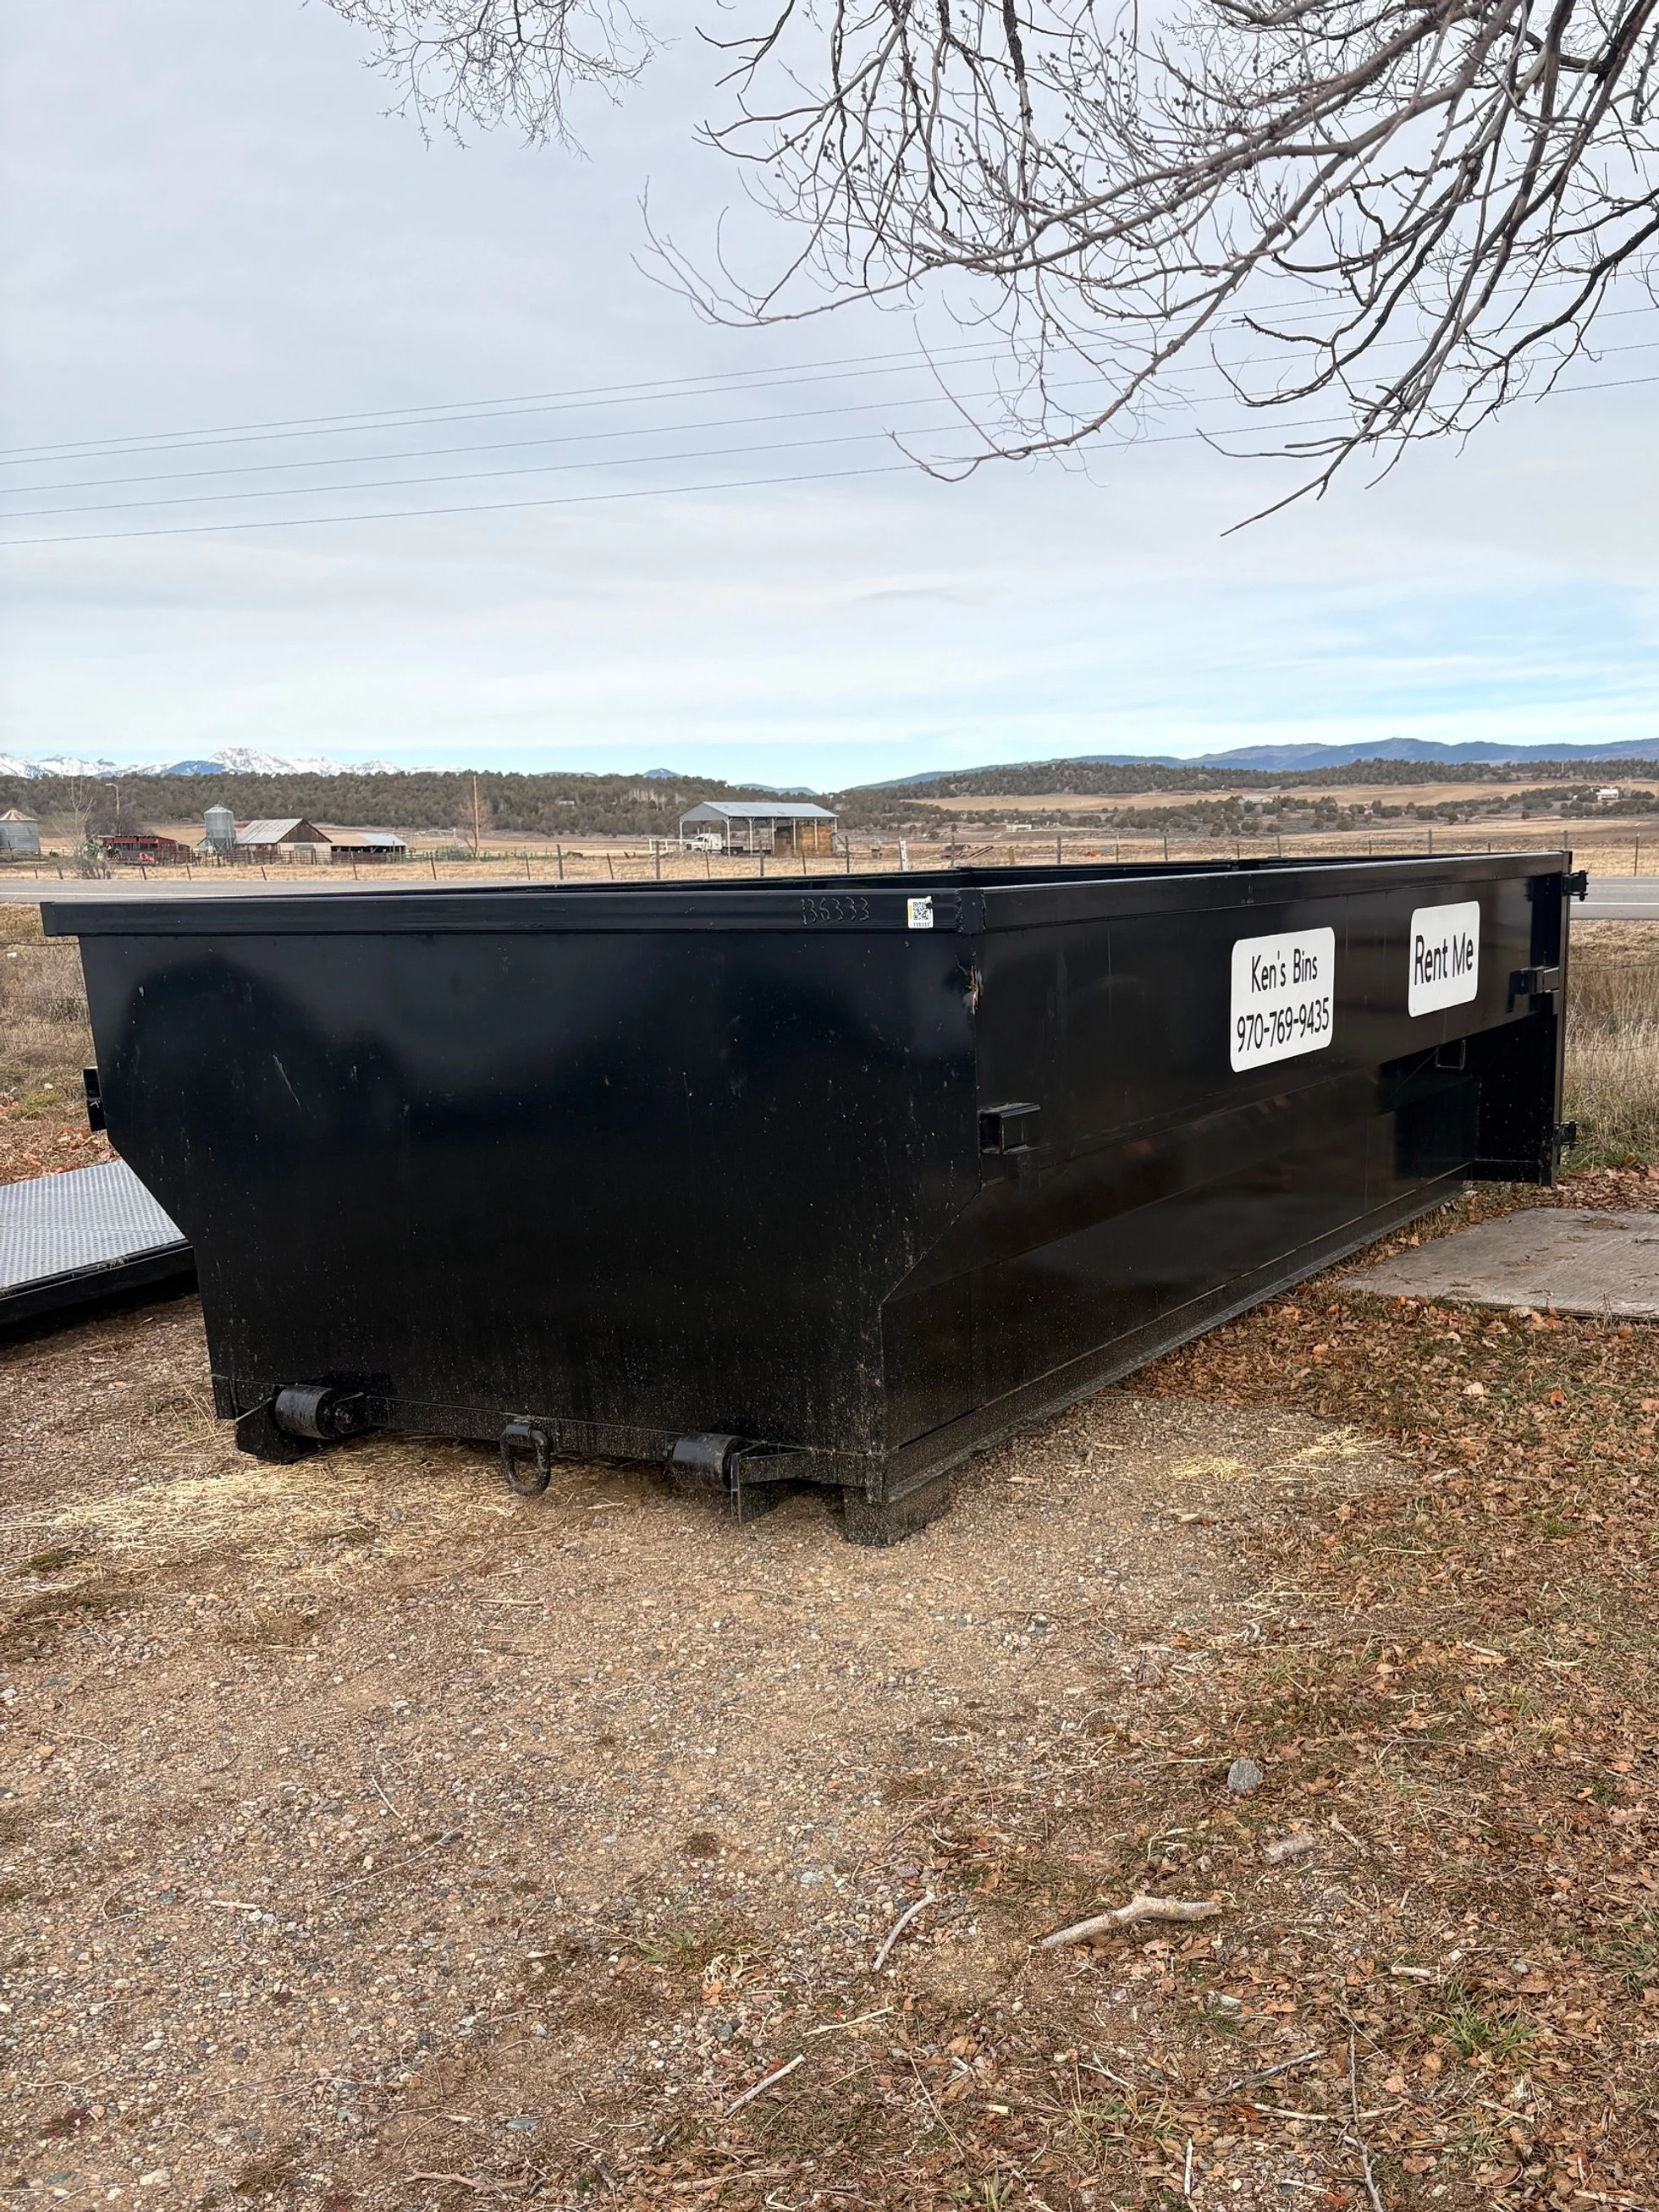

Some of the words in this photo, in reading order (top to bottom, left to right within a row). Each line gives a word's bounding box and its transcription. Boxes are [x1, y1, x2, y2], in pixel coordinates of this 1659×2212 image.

[1251, 950, 1286, 993] Ken's
[1292, 949, 1318, 983] Bins
[1414, 935, 1448, 986] Rent
[1452, 932, 1474, 977] Me
[1237, 997, 1329, 1053] 970-769-9435
